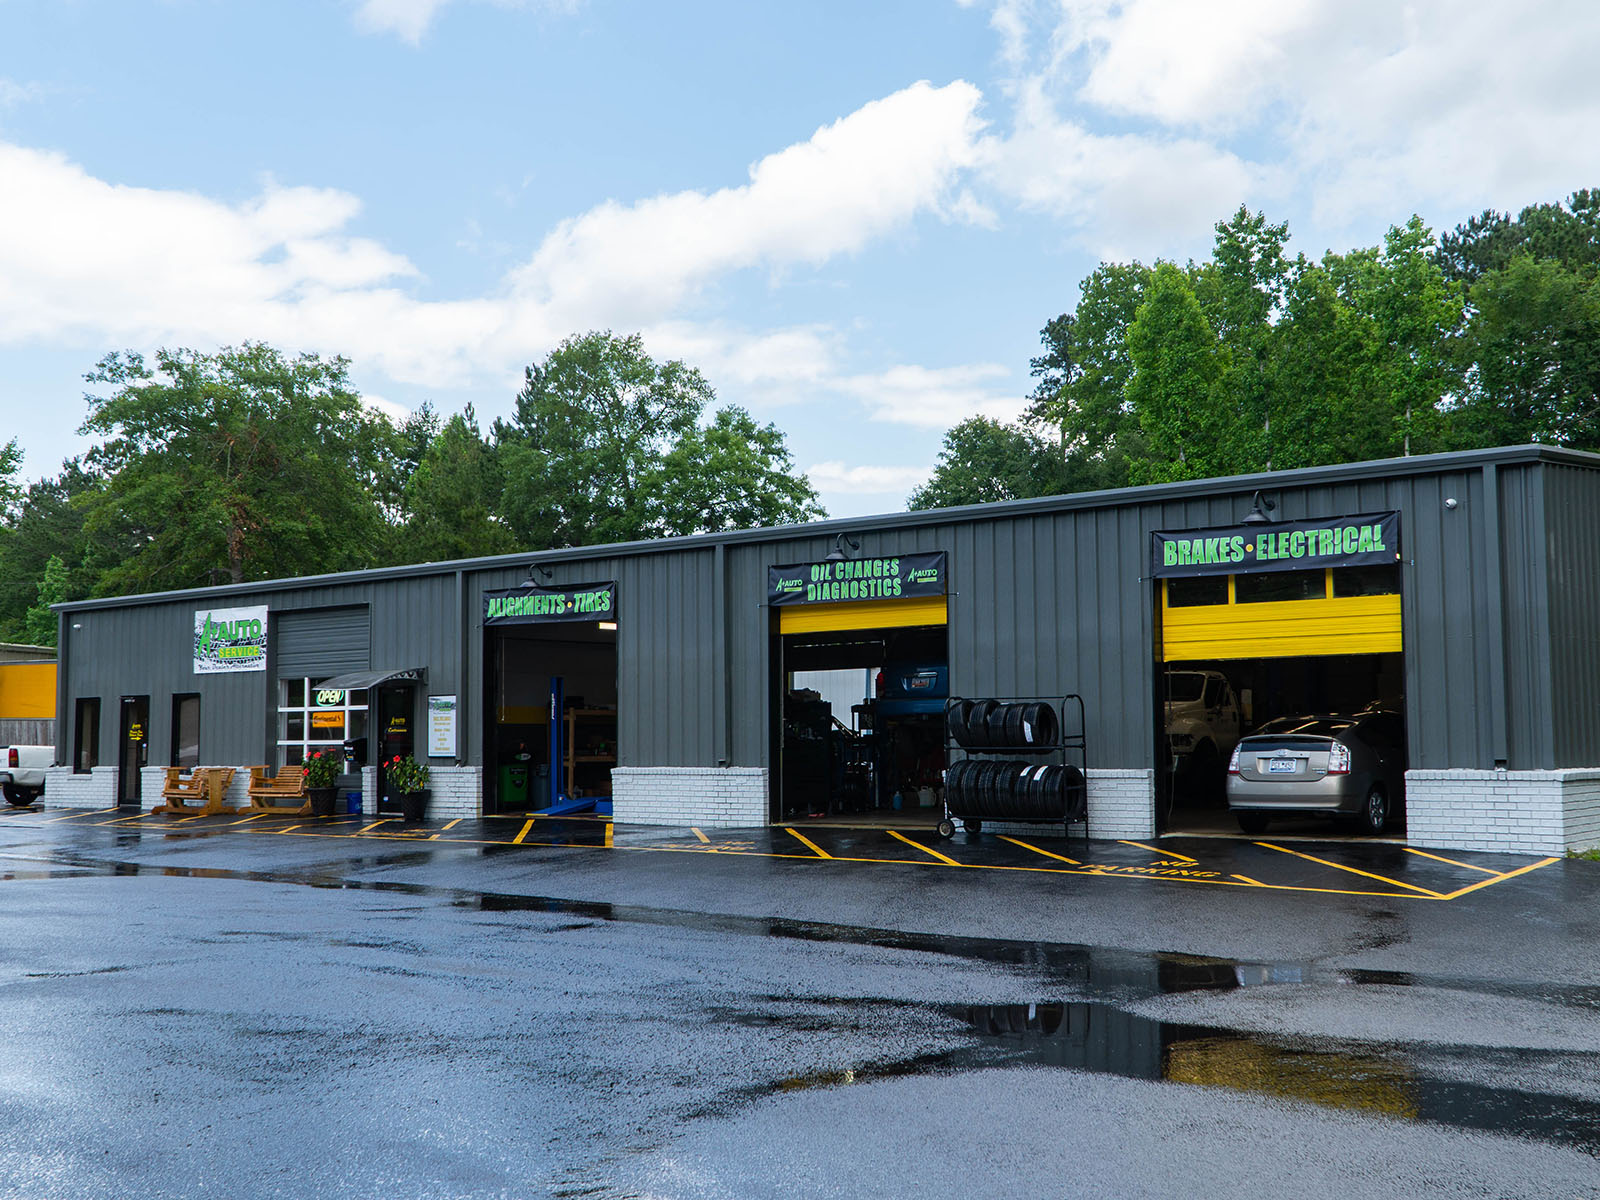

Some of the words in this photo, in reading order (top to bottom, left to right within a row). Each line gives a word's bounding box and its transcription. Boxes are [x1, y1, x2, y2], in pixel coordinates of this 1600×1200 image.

[1163, 535, 1245, 566] BRAKES
[1256, 524, 1386, 561] ELECTRICAL
[811, 564, 832, 582] OIL
[835, 558, 900, 580] CHANGES
[807, 577, 902, 601] DIAGNOSTICS
[487, 593, 566, 618] ALIGNMENTS
[573, 590, 611, 613] TIRES
[217, 618, 262, 641] AUTO
[219, 646, 260, 658] SERVICE
[318, 689, 342, 703] OPEN
[1077, 863, 1222, 878] PARKING
